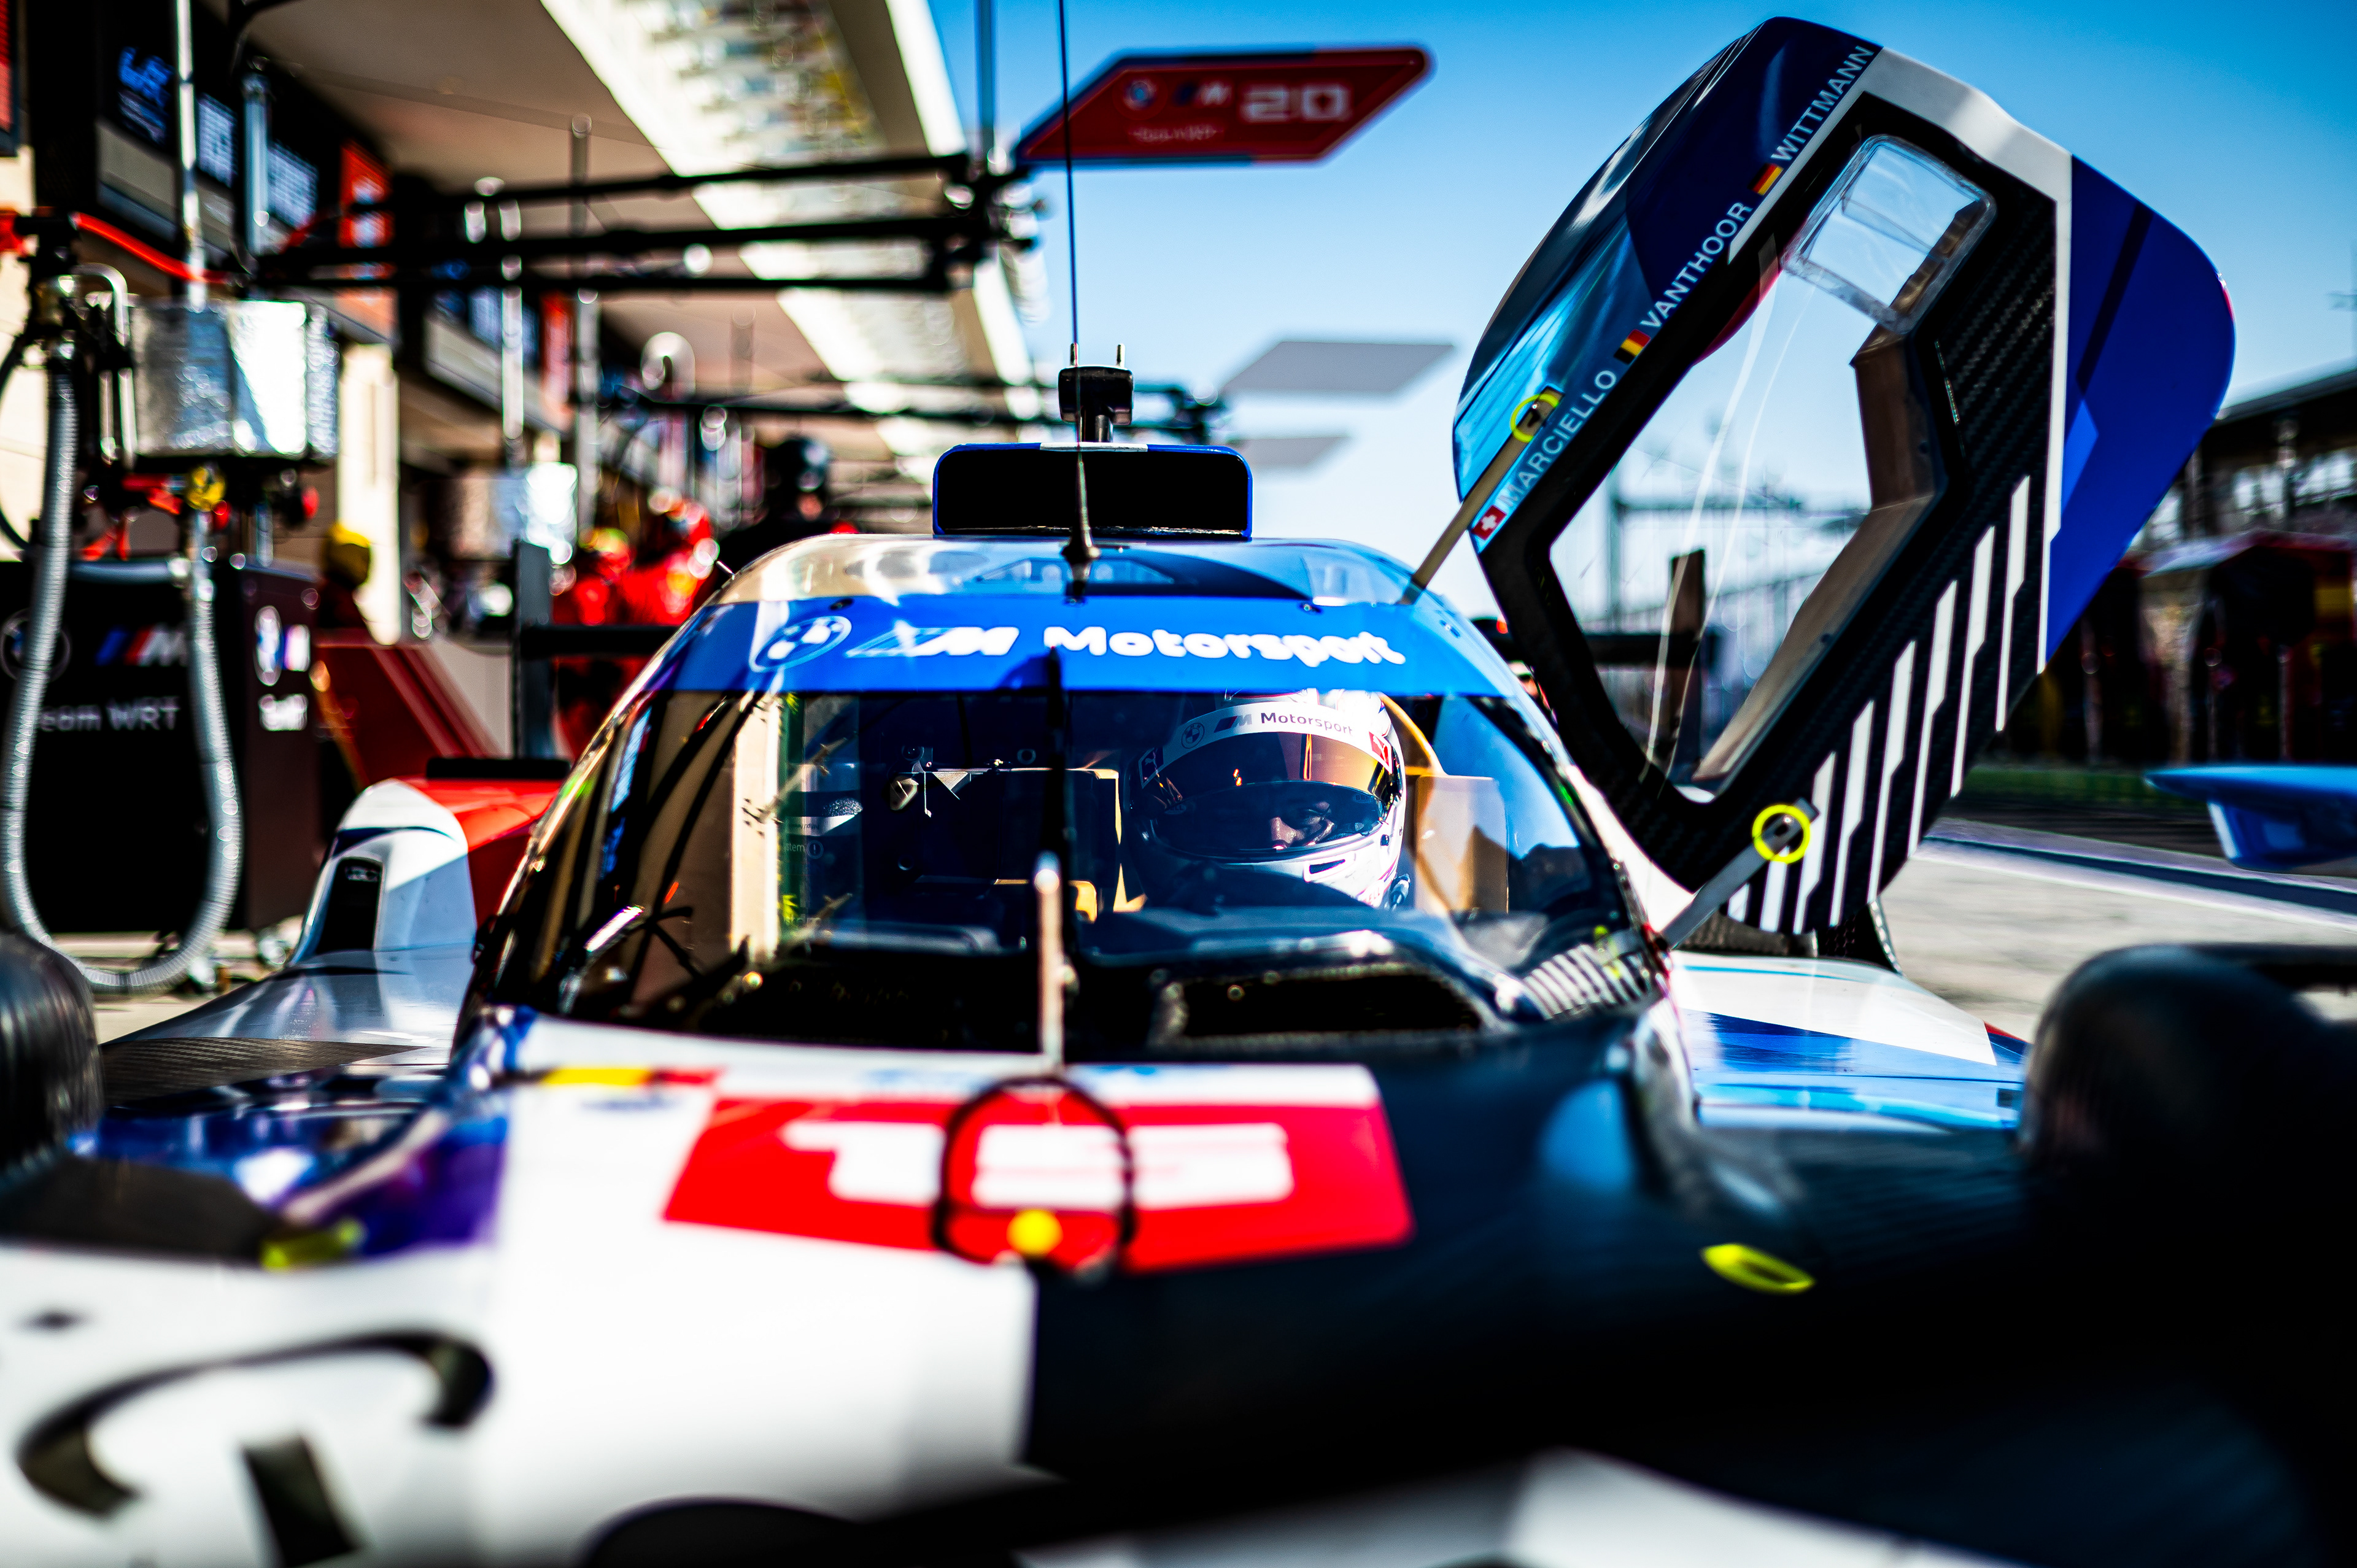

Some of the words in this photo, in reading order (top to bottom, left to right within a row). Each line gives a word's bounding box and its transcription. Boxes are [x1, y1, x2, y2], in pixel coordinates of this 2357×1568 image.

[1239, 84, 1352, 122] 20
[1771, 45, 1875, 162] WITTMANN
[1640, 201, 1754, 330] VANTHOOR
[1498, 369, 1617, 507] MARCIELLO
[1043, 626, 1406, 668] Motorsport
[39, 705, 101, 732] eam
[106, 696, 180, 731] WRT
[1260, 712, 1354, 737] Motorsport
